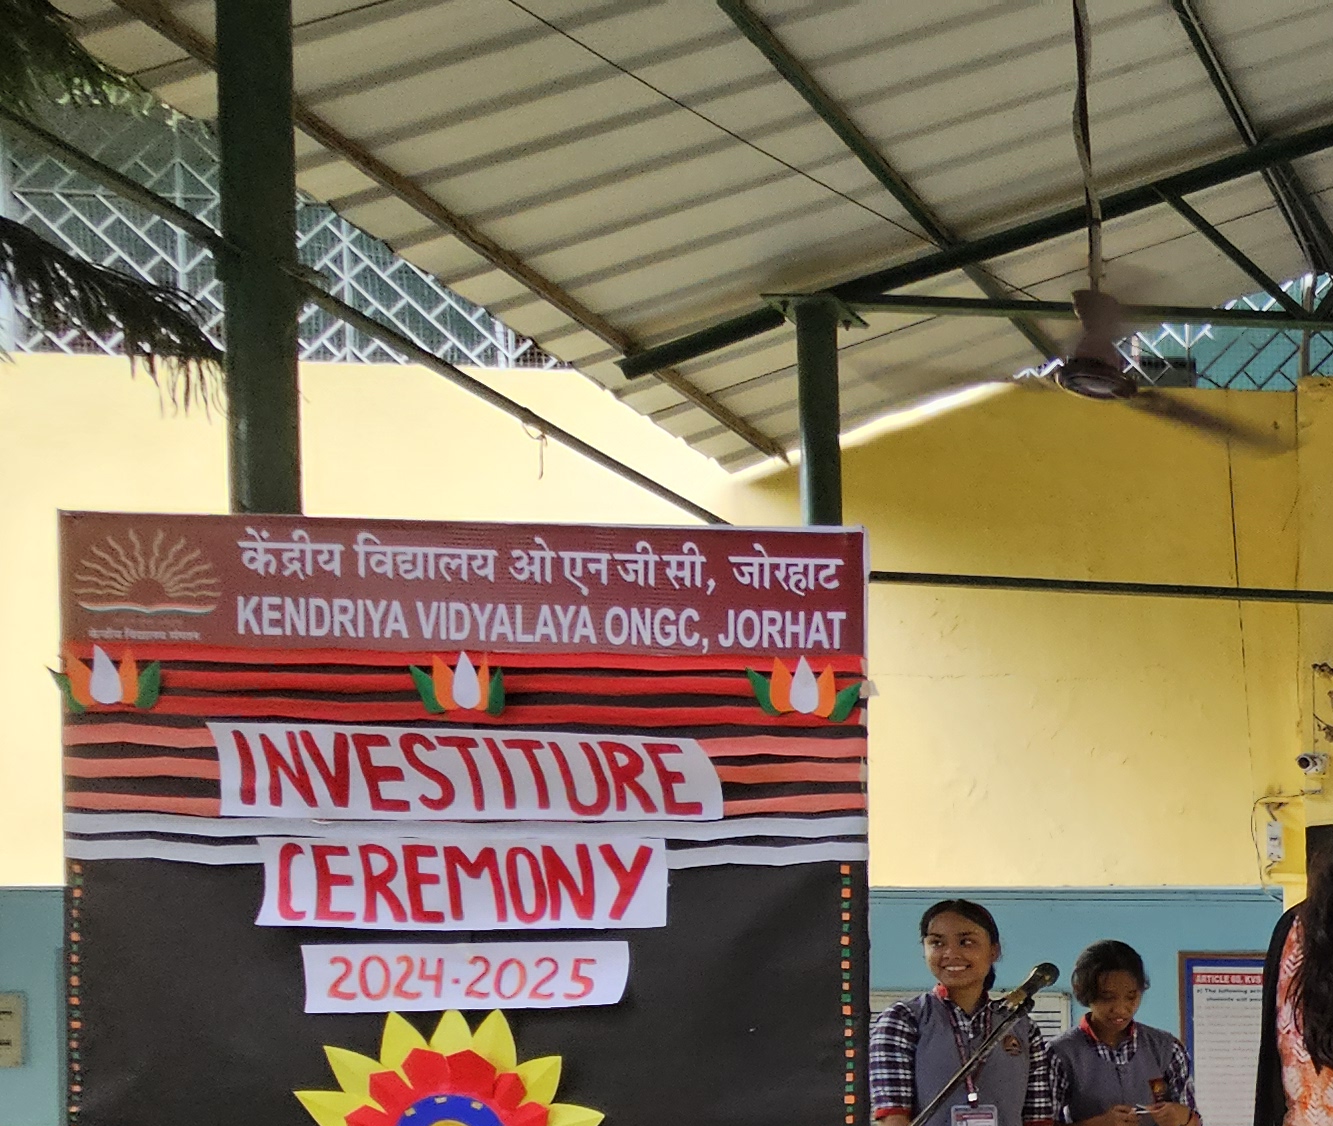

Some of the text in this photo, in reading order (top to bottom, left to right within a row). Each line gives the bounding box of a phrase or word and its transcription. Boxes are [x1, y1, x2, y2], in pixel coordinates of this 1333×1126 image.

[237, 526, 344, 580] केंद्रीय
[354, 533, 498, 584] विद्यालय
[728, 542, 845, 596] जोरहाट
[236, 595, 847, 654] KENDRIYA VIDYALAYA ONGC, JORHAT
[232, 730, 704, 816] INVESTITURE
[277, 842, 653, 924] CEREMONY
